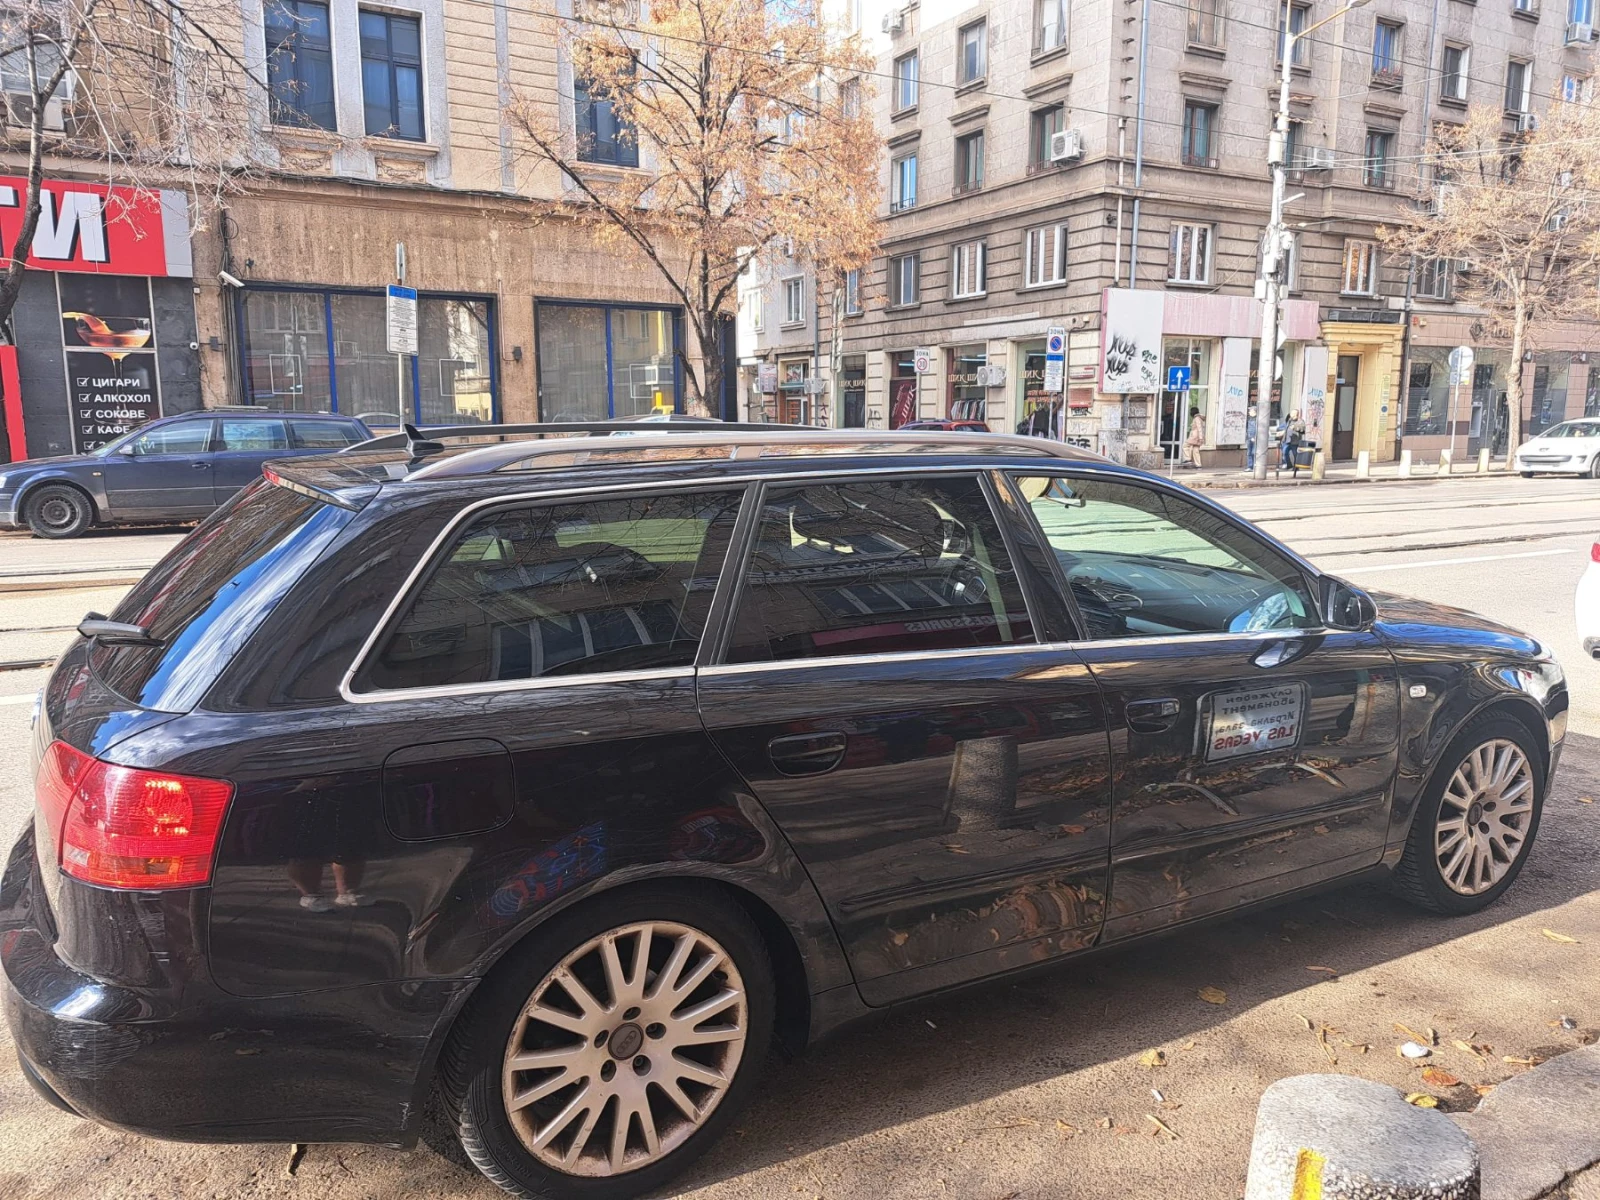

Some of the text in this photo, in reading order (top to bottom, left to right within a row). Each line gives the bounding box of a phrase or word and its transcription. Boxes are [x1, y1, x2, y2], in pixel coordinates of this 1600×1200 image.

[92, 378, 141, 388] ЦИГАРИ
[94, 394, 151, 403] АЛКОХОЛ
[95, 409, 146, 419] СОКОВЕ
[97, 425, 130, 434] КАФЕ
